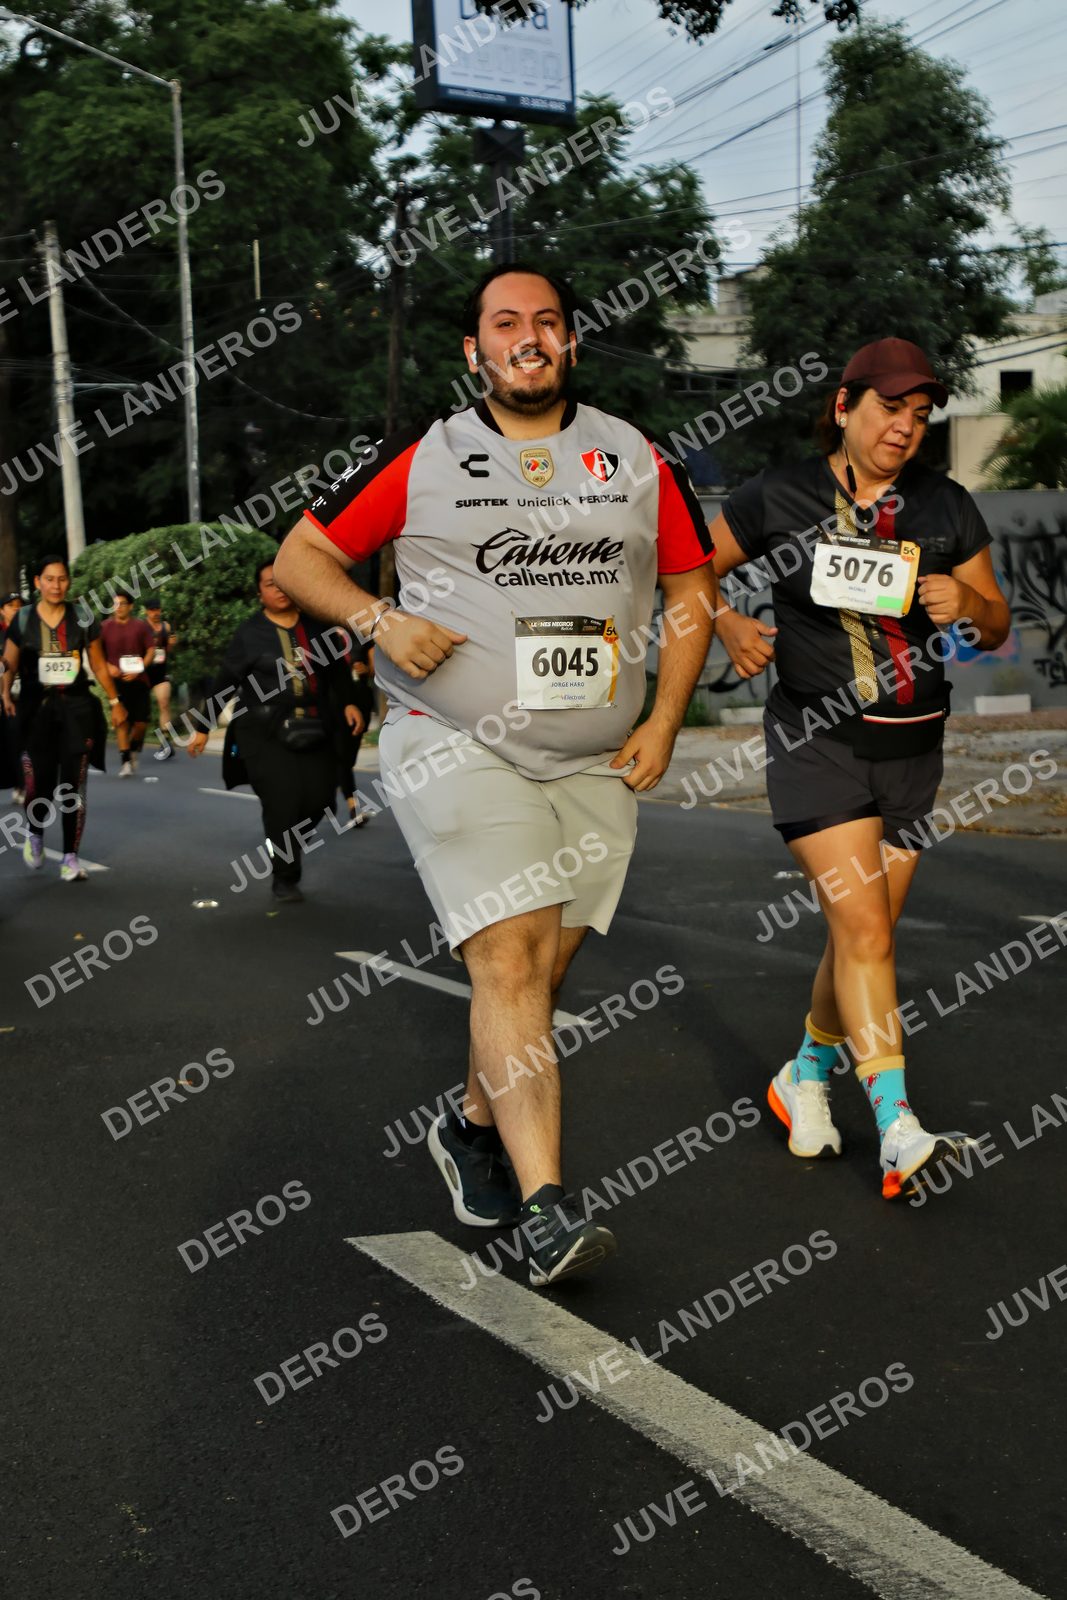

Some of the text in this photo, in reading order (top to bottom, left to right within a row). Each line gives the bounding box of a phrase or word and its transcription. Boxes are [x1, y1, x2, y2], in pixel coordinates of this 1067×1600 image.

[455, 498, 509, 508] SURTEK
[517, 497, 572, 507] Uniclick
[579, 494, 629, 504] PERDURA
[470, 527, 625, 574] Caliente
[494, 568, 620, 587] caliente.mx
[826, 555, 894, 587] 5076
[45, 661, 72, 672] 5052
[532, 647, 599, 678] 6045
